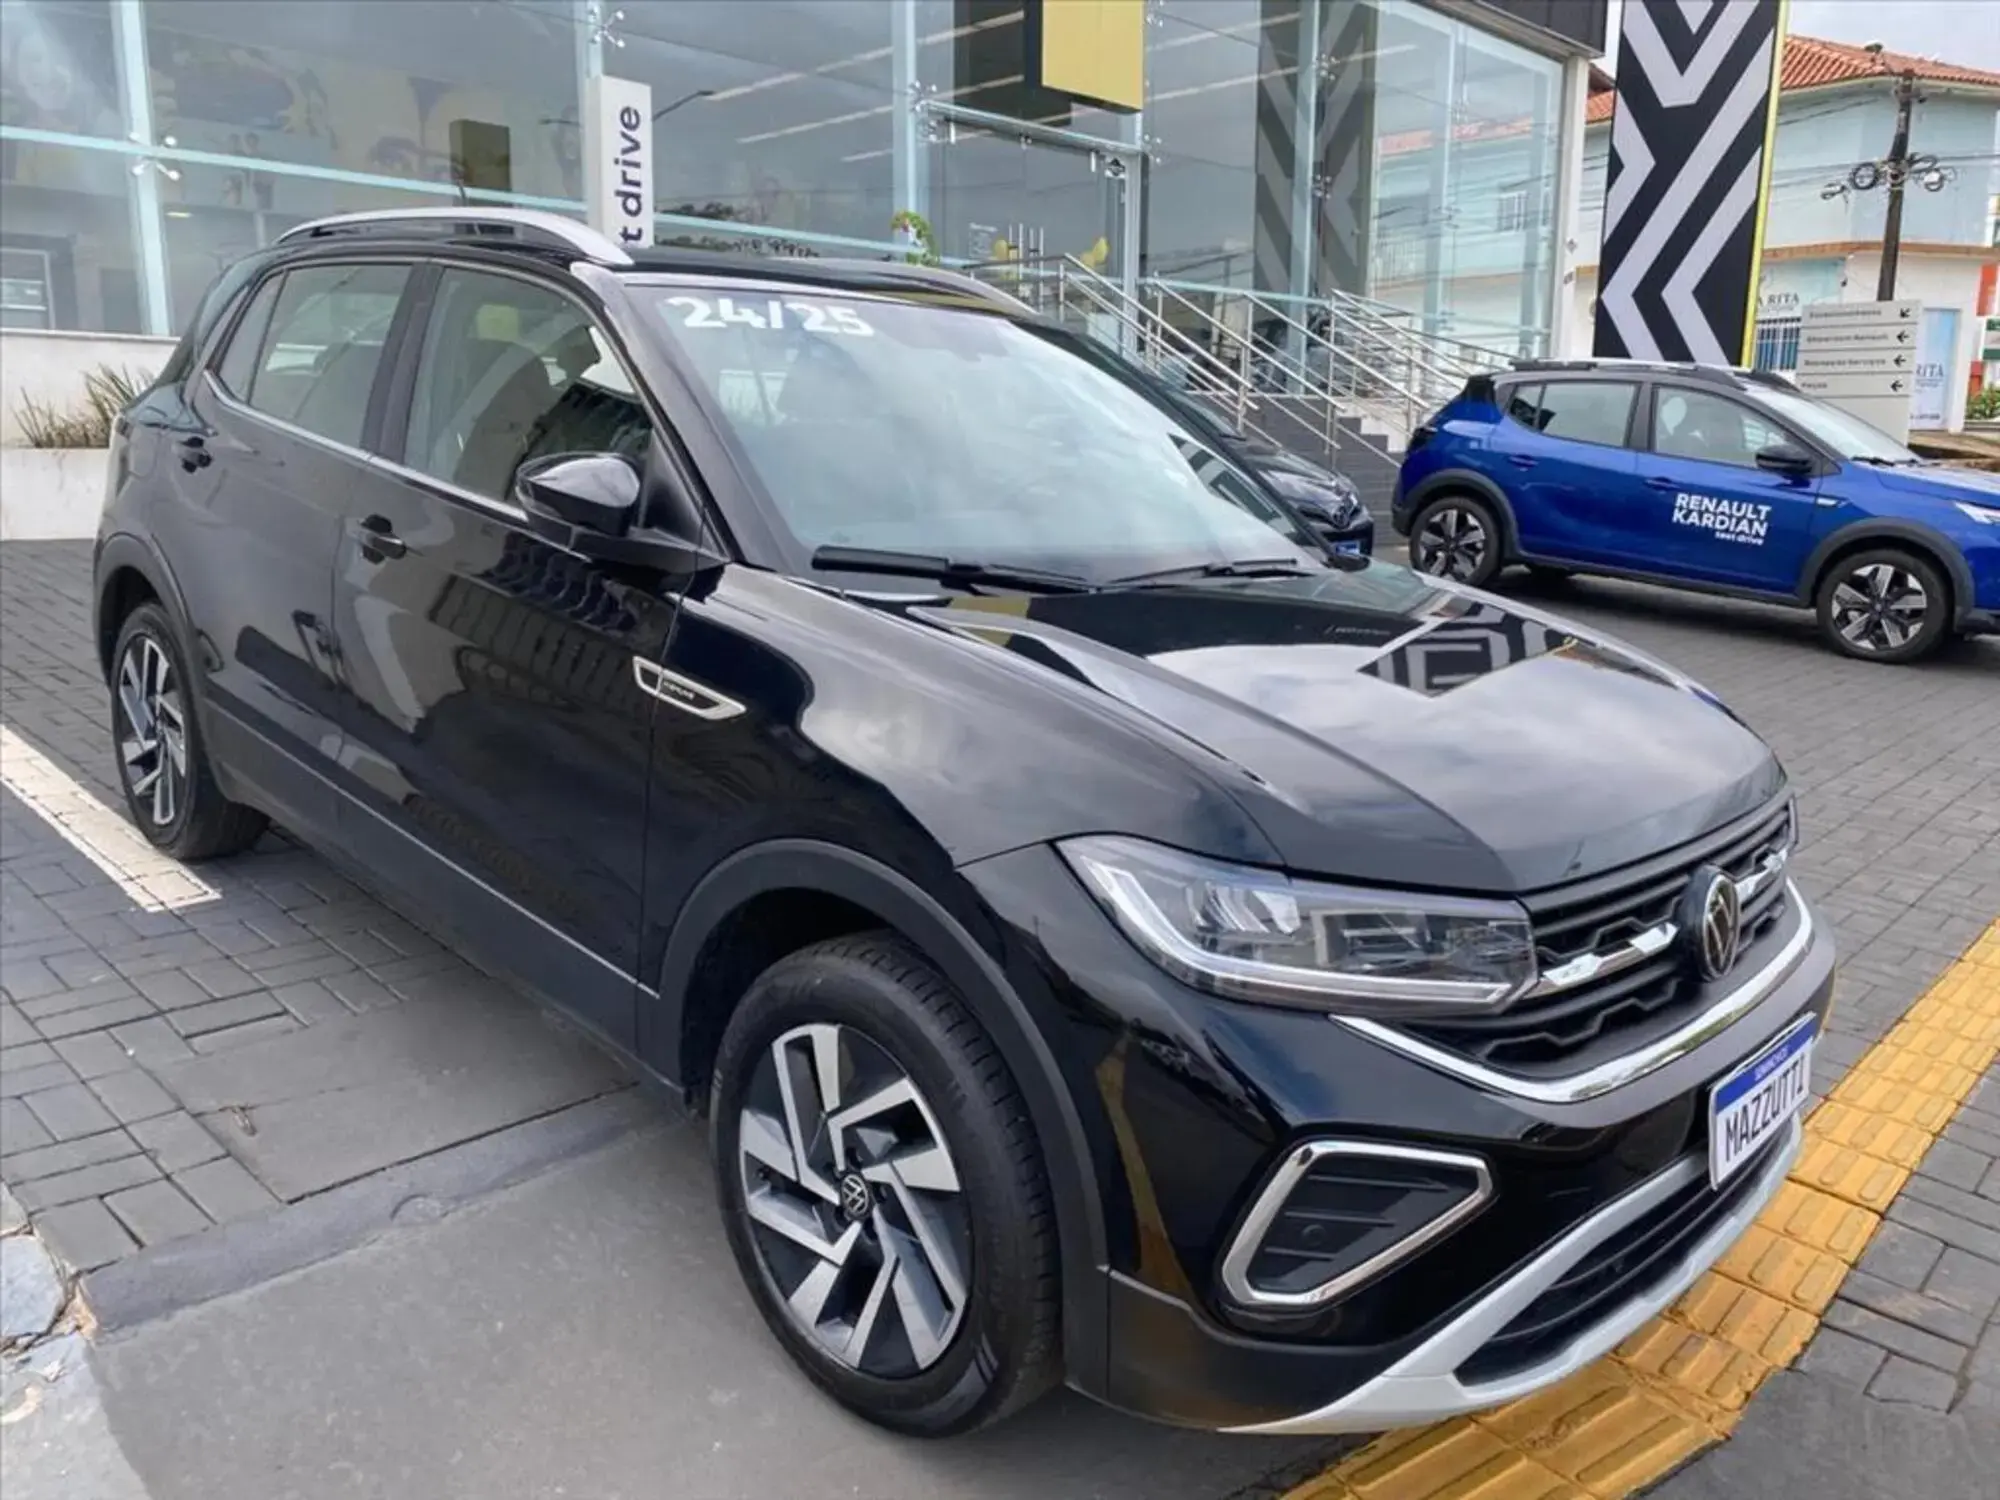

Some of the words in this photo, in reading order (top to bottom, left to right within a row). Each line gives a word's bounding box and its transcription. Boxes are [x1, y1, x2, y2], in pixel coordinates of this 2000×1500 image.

[614, 106, 642, 217] drive
[1672, 507, 1768, 537] KARDIAN
[1675, 493, 1772, 520] RENAULT
[1725, 1052, 1806, 1162] MAZZUTTI
